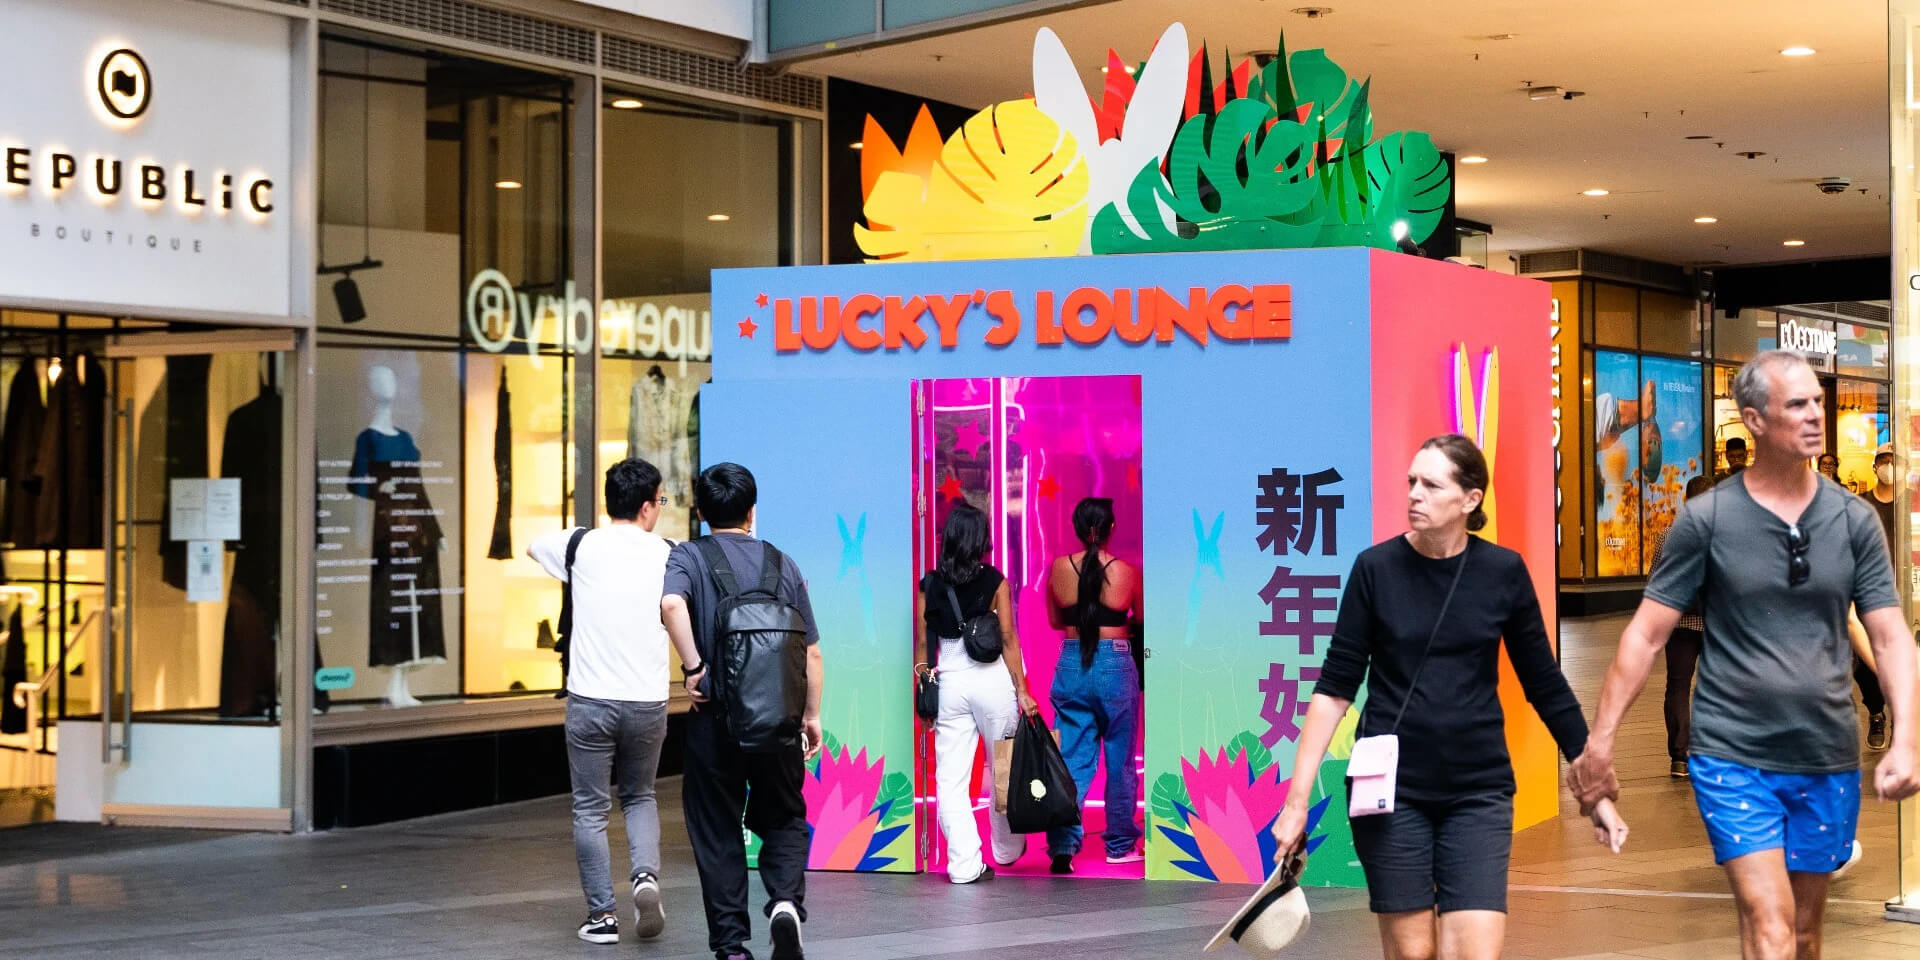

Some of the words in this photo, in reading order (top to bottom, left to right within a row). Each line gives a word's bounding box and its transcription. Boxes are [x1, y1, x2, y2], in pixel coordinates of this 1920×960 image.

[31, 223, 202, 252] BOUTIQUE
[775, 288, 1022, 352] LUCKY'S
[1035, 284, 1292, 348] LOUNGE
